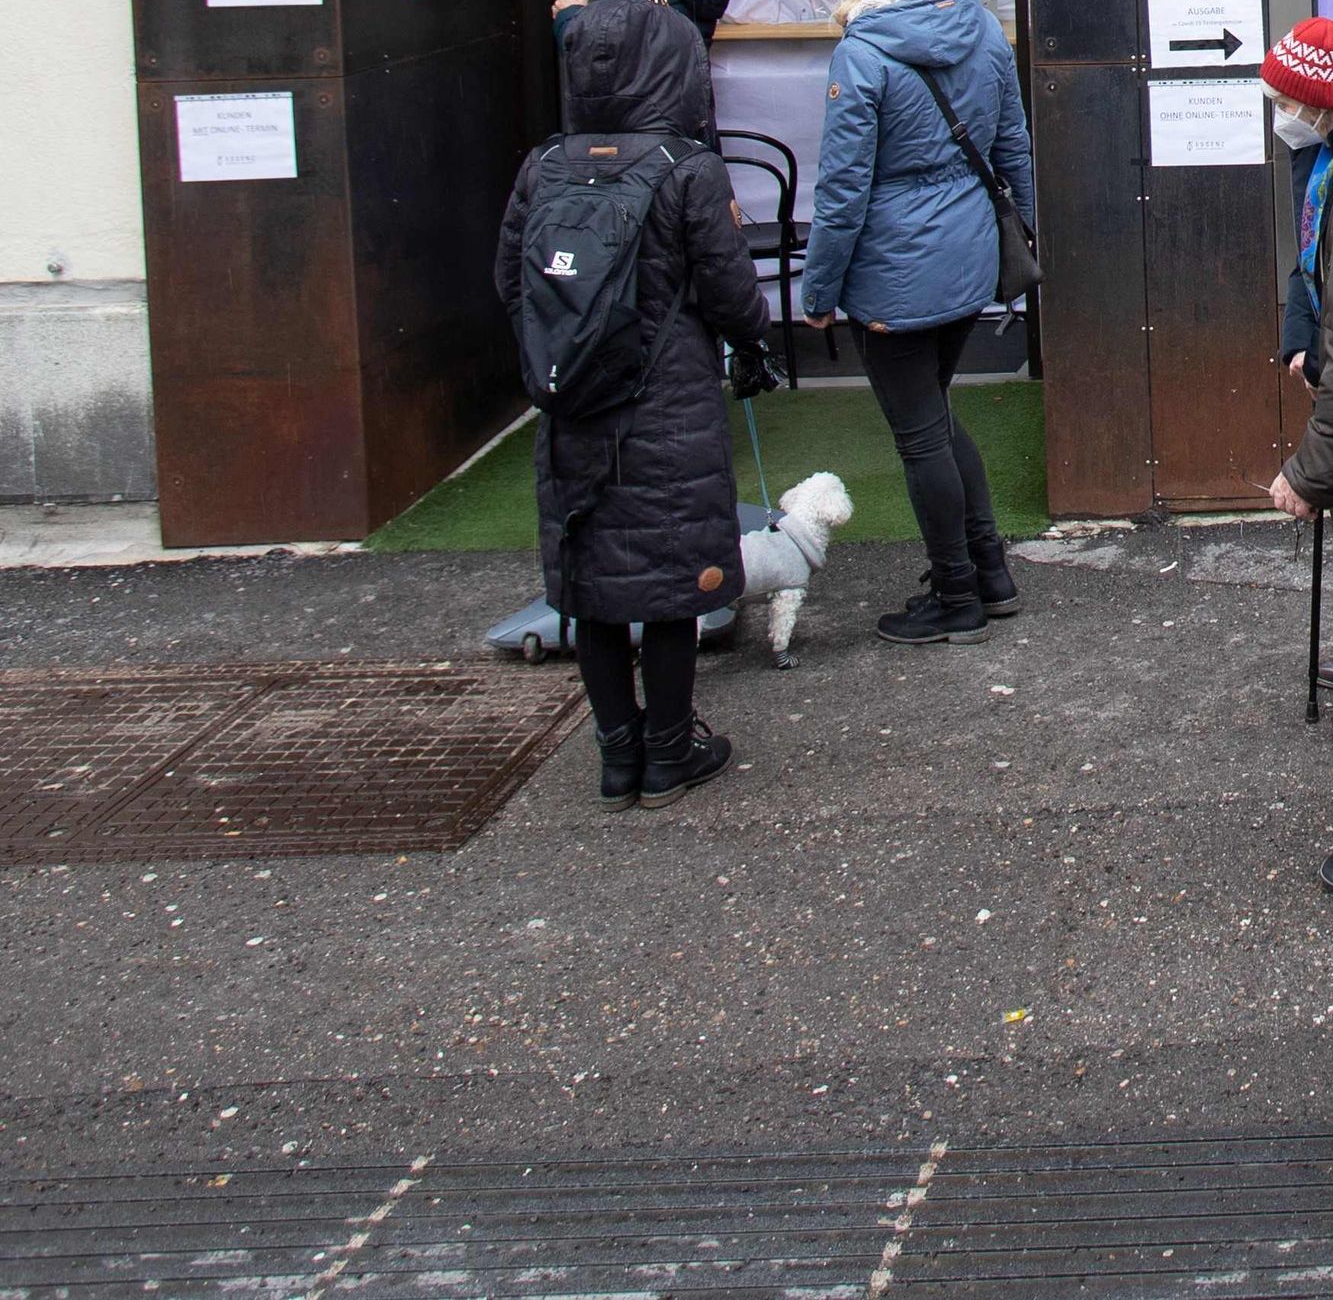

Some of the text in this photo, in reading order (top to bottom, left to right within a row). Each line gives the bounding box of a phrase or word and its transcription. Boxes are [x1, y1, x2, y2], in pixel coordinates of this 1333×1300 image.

[1188, 7, 1225, 15] AUSGABE
[1160, 111, 1183, 120] OHNE
[1221, 110, 1252, 118] TERMIN
[544, 267, 578, 276] salomon
